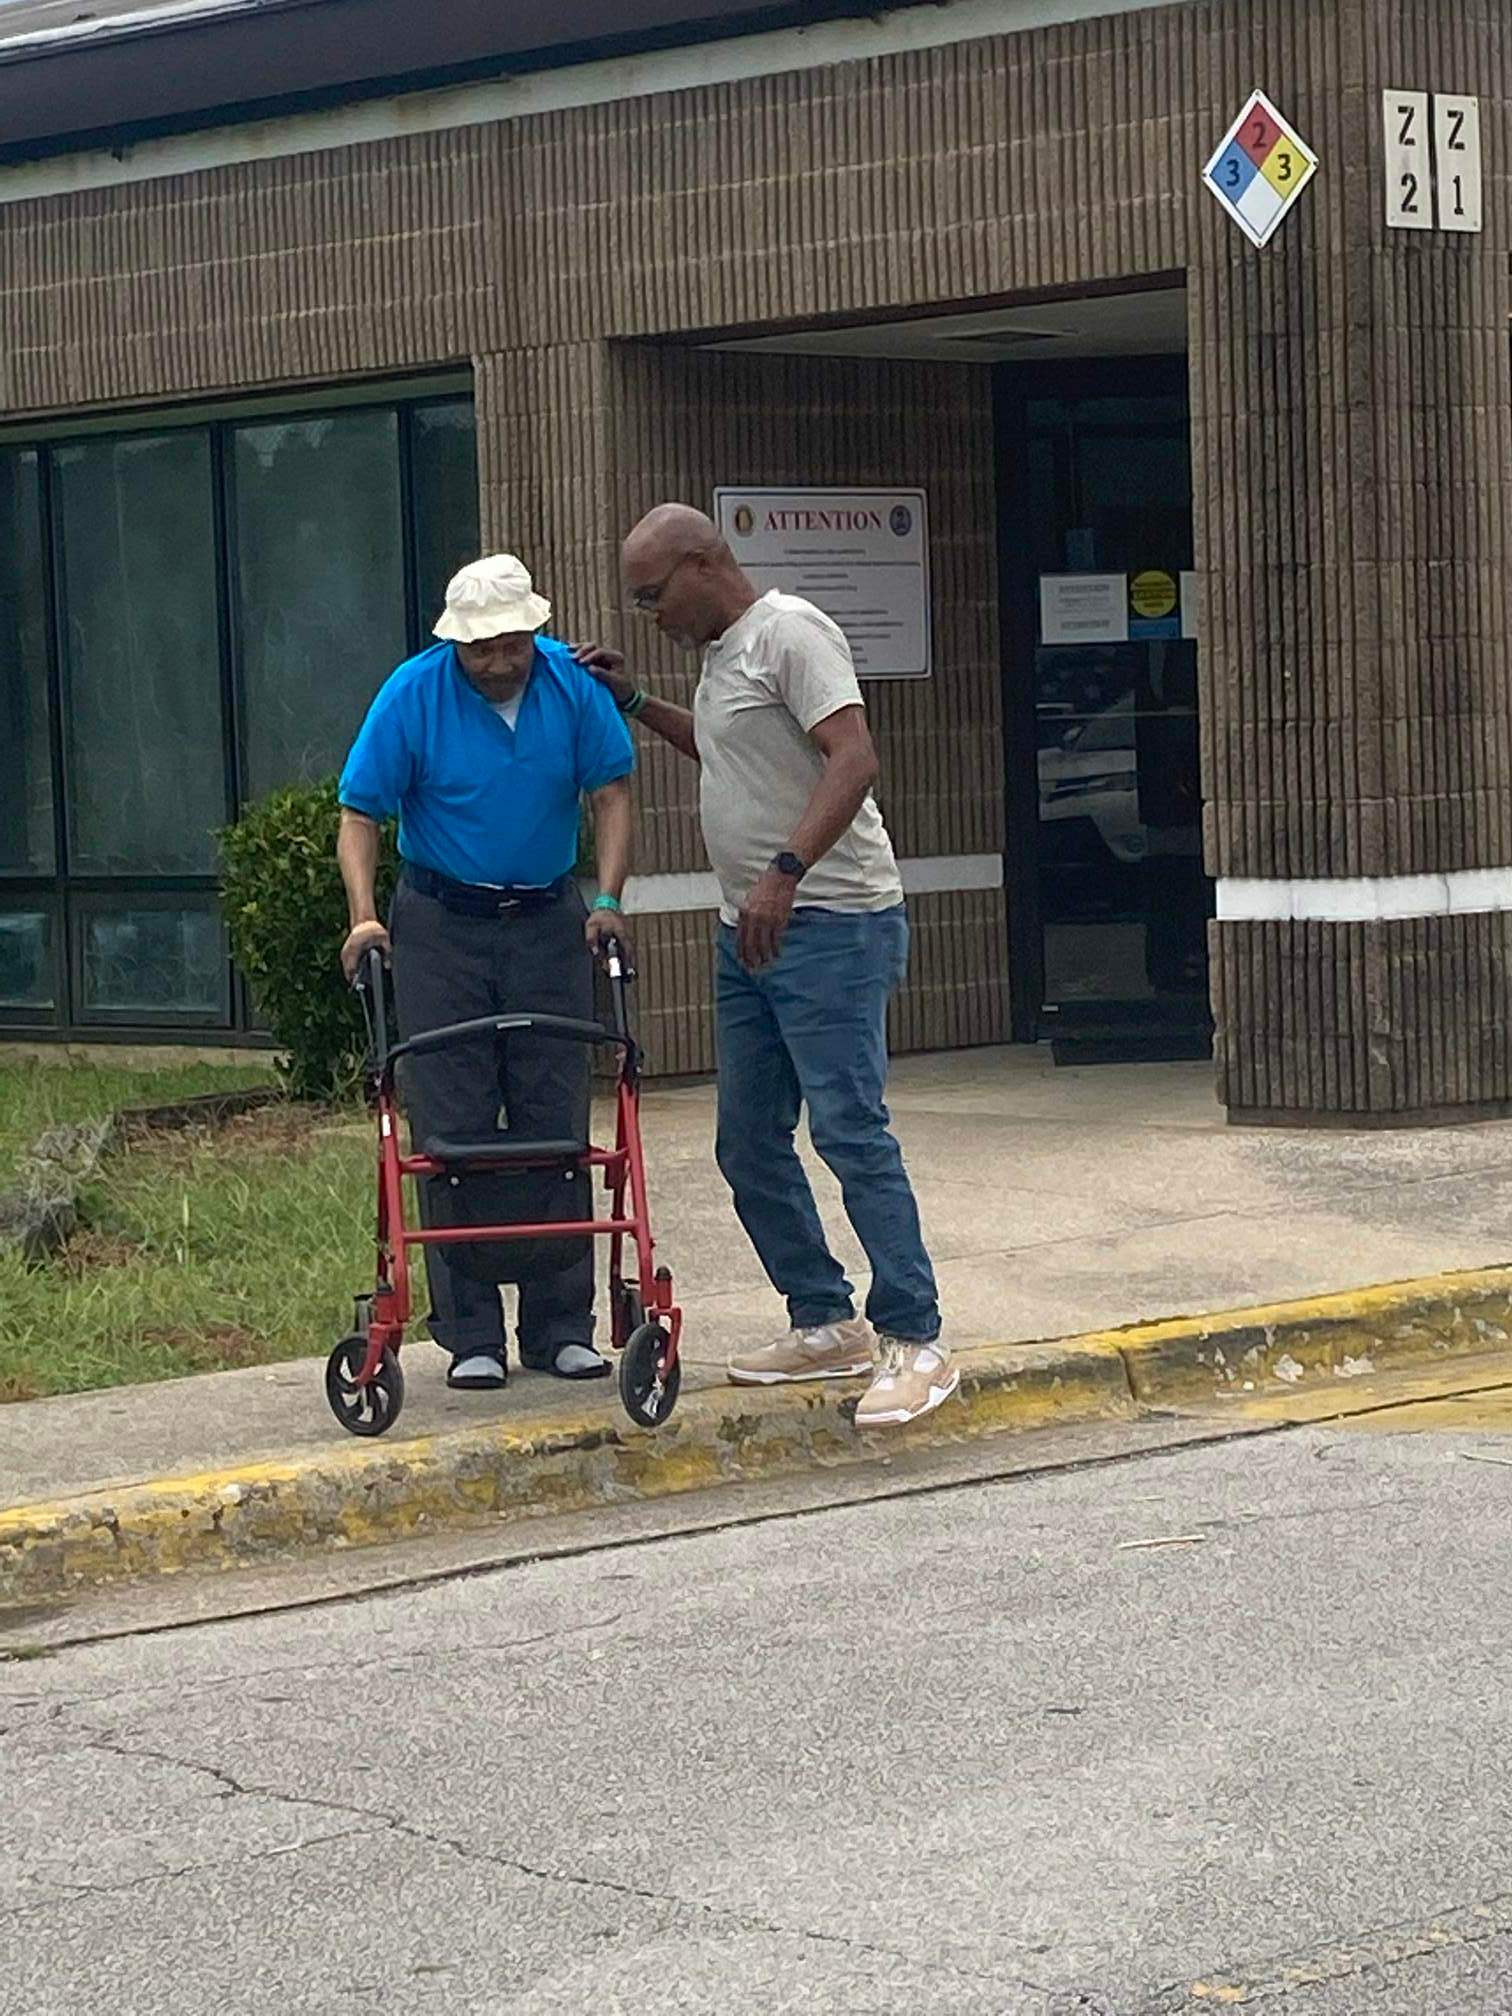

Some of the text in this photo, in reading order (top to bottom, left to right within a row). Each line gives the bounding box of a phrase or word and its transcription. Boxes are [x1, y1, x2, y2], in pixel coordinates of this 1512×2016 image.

[1252, 121, 1267, 148] 2
[1226, 158, 1241, 187] 3
[1277, 153, 1292, 181] 3
[1401, 172, 1465, 216] 2 1
[765, 510, 882, 530] ATTENTION
